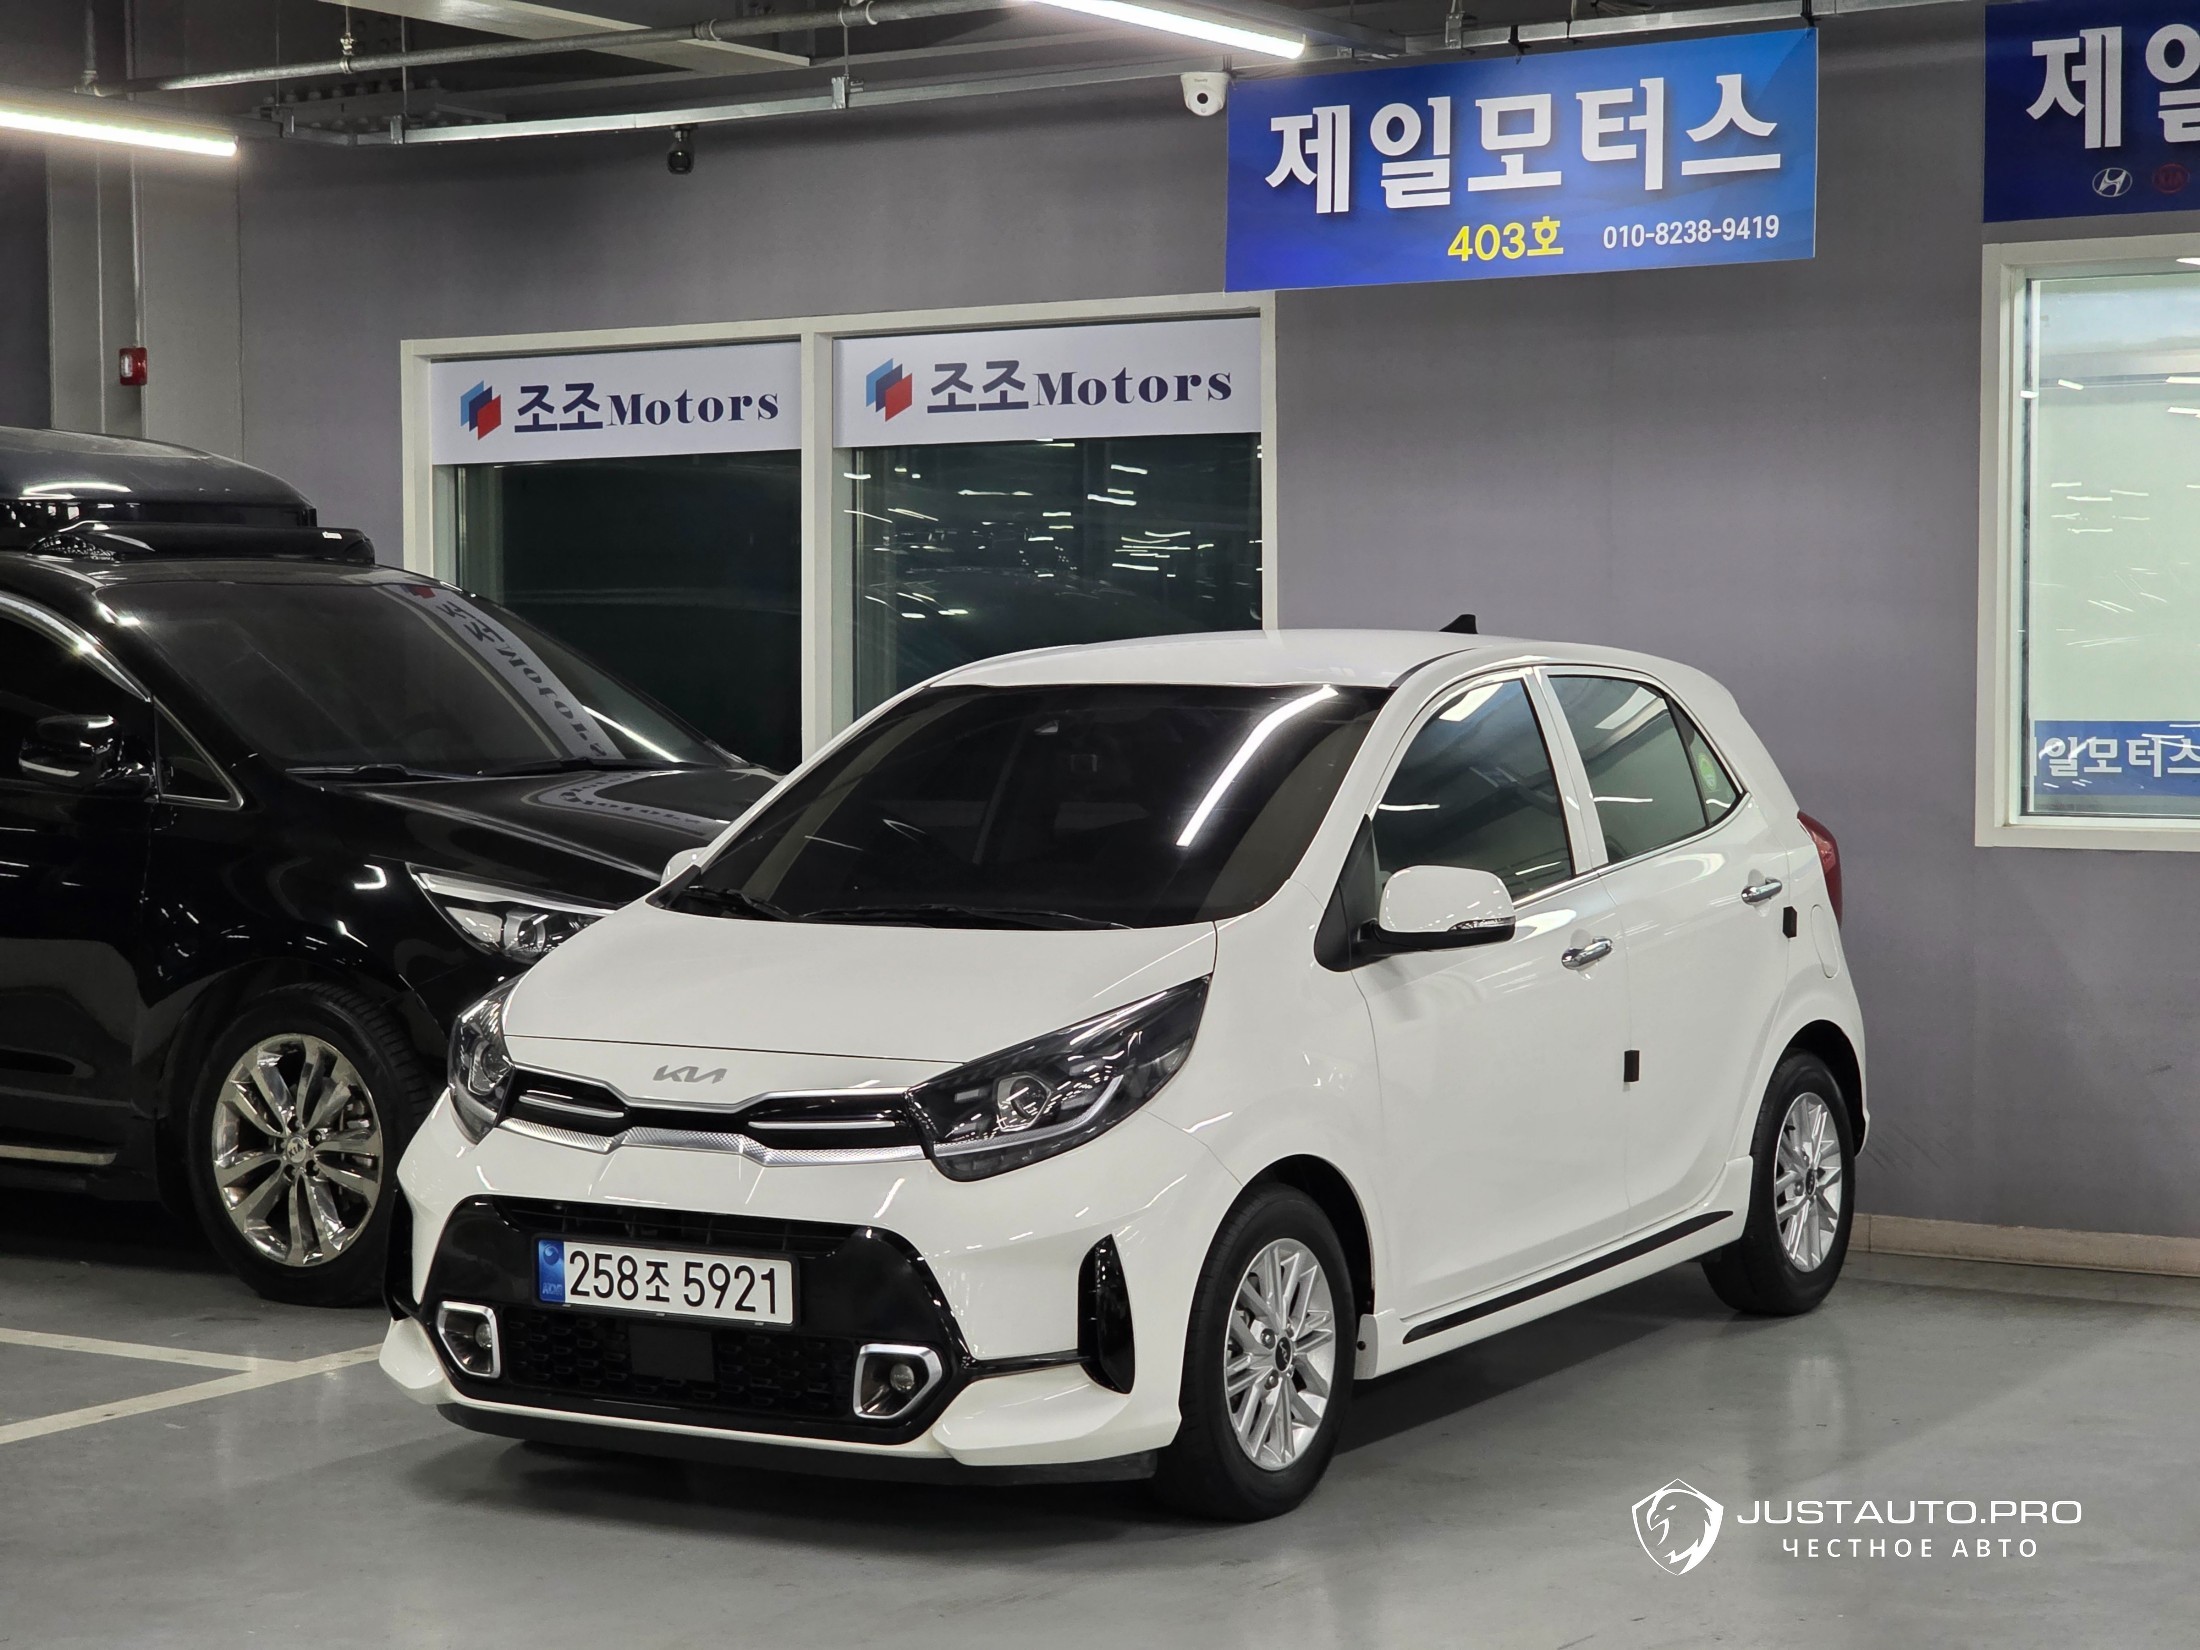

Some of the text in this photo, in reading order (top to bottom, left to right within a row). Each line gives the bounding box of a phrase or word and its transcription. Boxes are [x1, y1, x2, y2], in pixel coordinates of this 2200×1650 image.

[1265, 73, 1781, 214] 제일모터스
[1447, 214, 1780, 262] 403호 010-8238-9419
[514, 382, 779, 433] 조조Motors
[927, 360, 1232, 414] 조조Motors
[2030, 736, 2200, 778] 일모터스
[569, 1250, 776, 1314] 258조 5921
